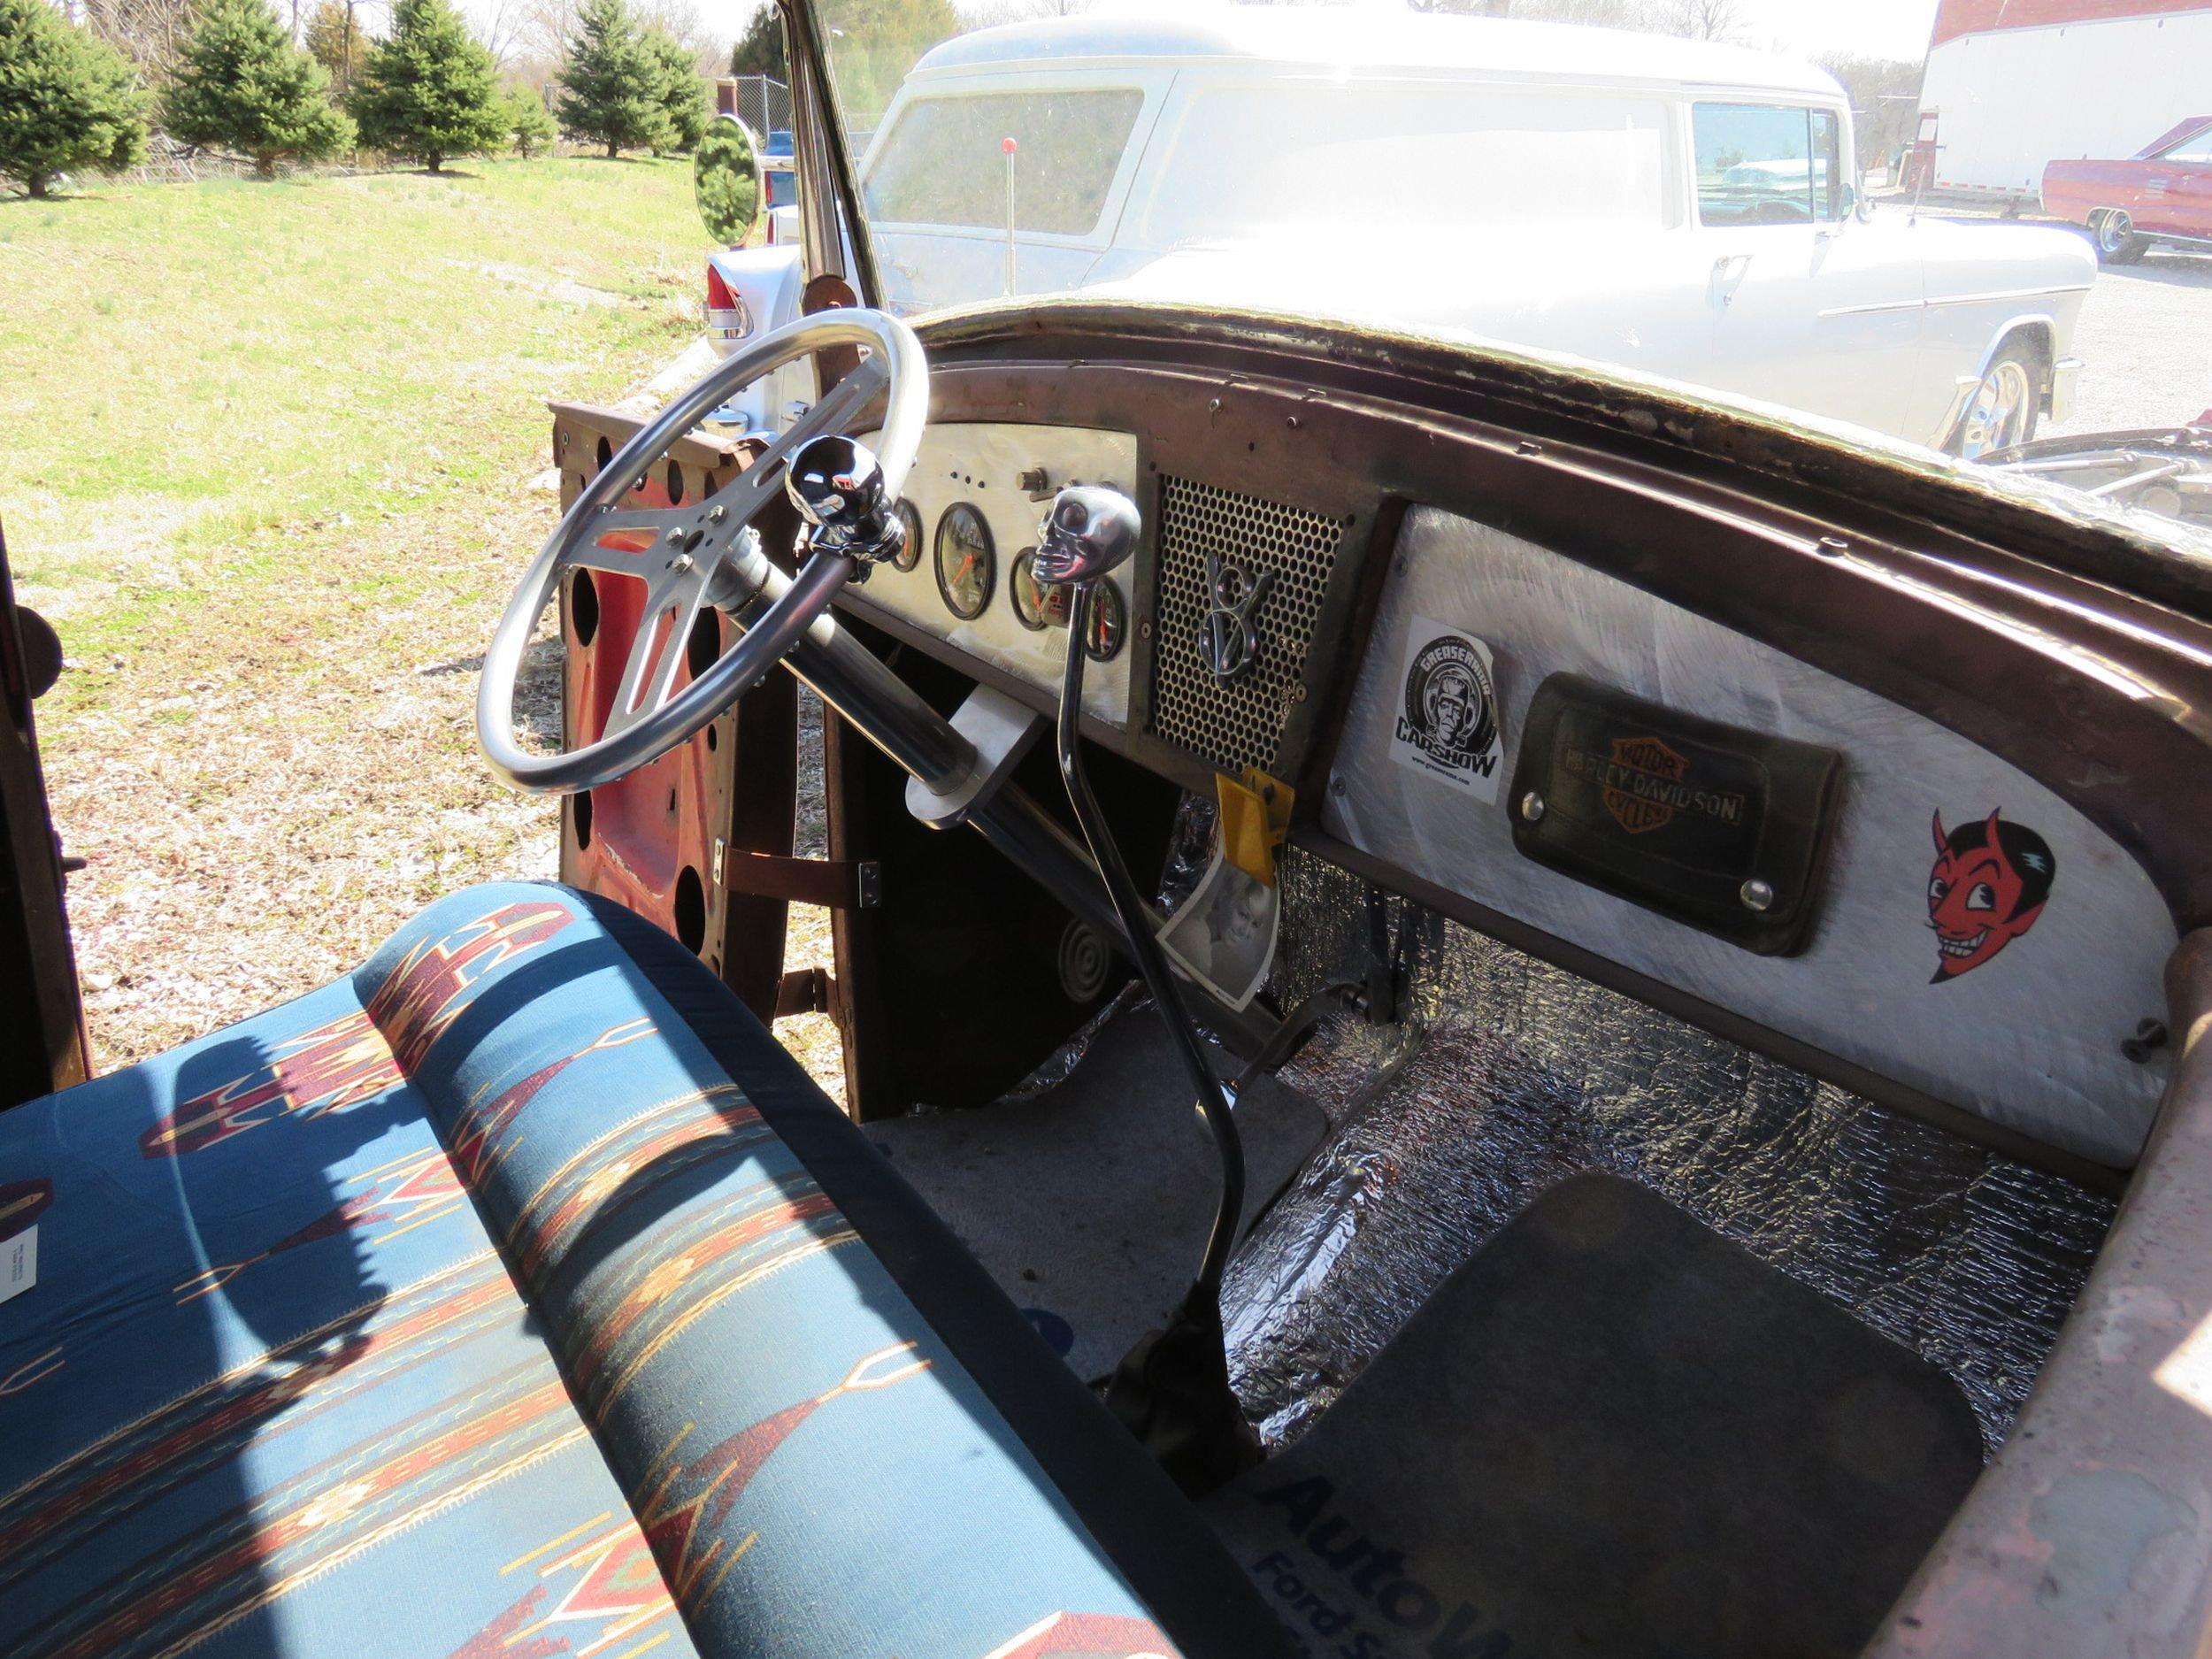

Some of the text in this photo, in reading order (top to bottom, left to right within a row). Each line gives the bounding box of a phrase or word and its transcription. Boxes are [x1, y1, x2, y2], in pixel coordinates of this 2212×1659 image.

[1421, 646, 1490, 695] GREASERAMA
[1395, 716, 1497, 779] CARSHOW
[1251, 1550, 1356, 1637] Ford
